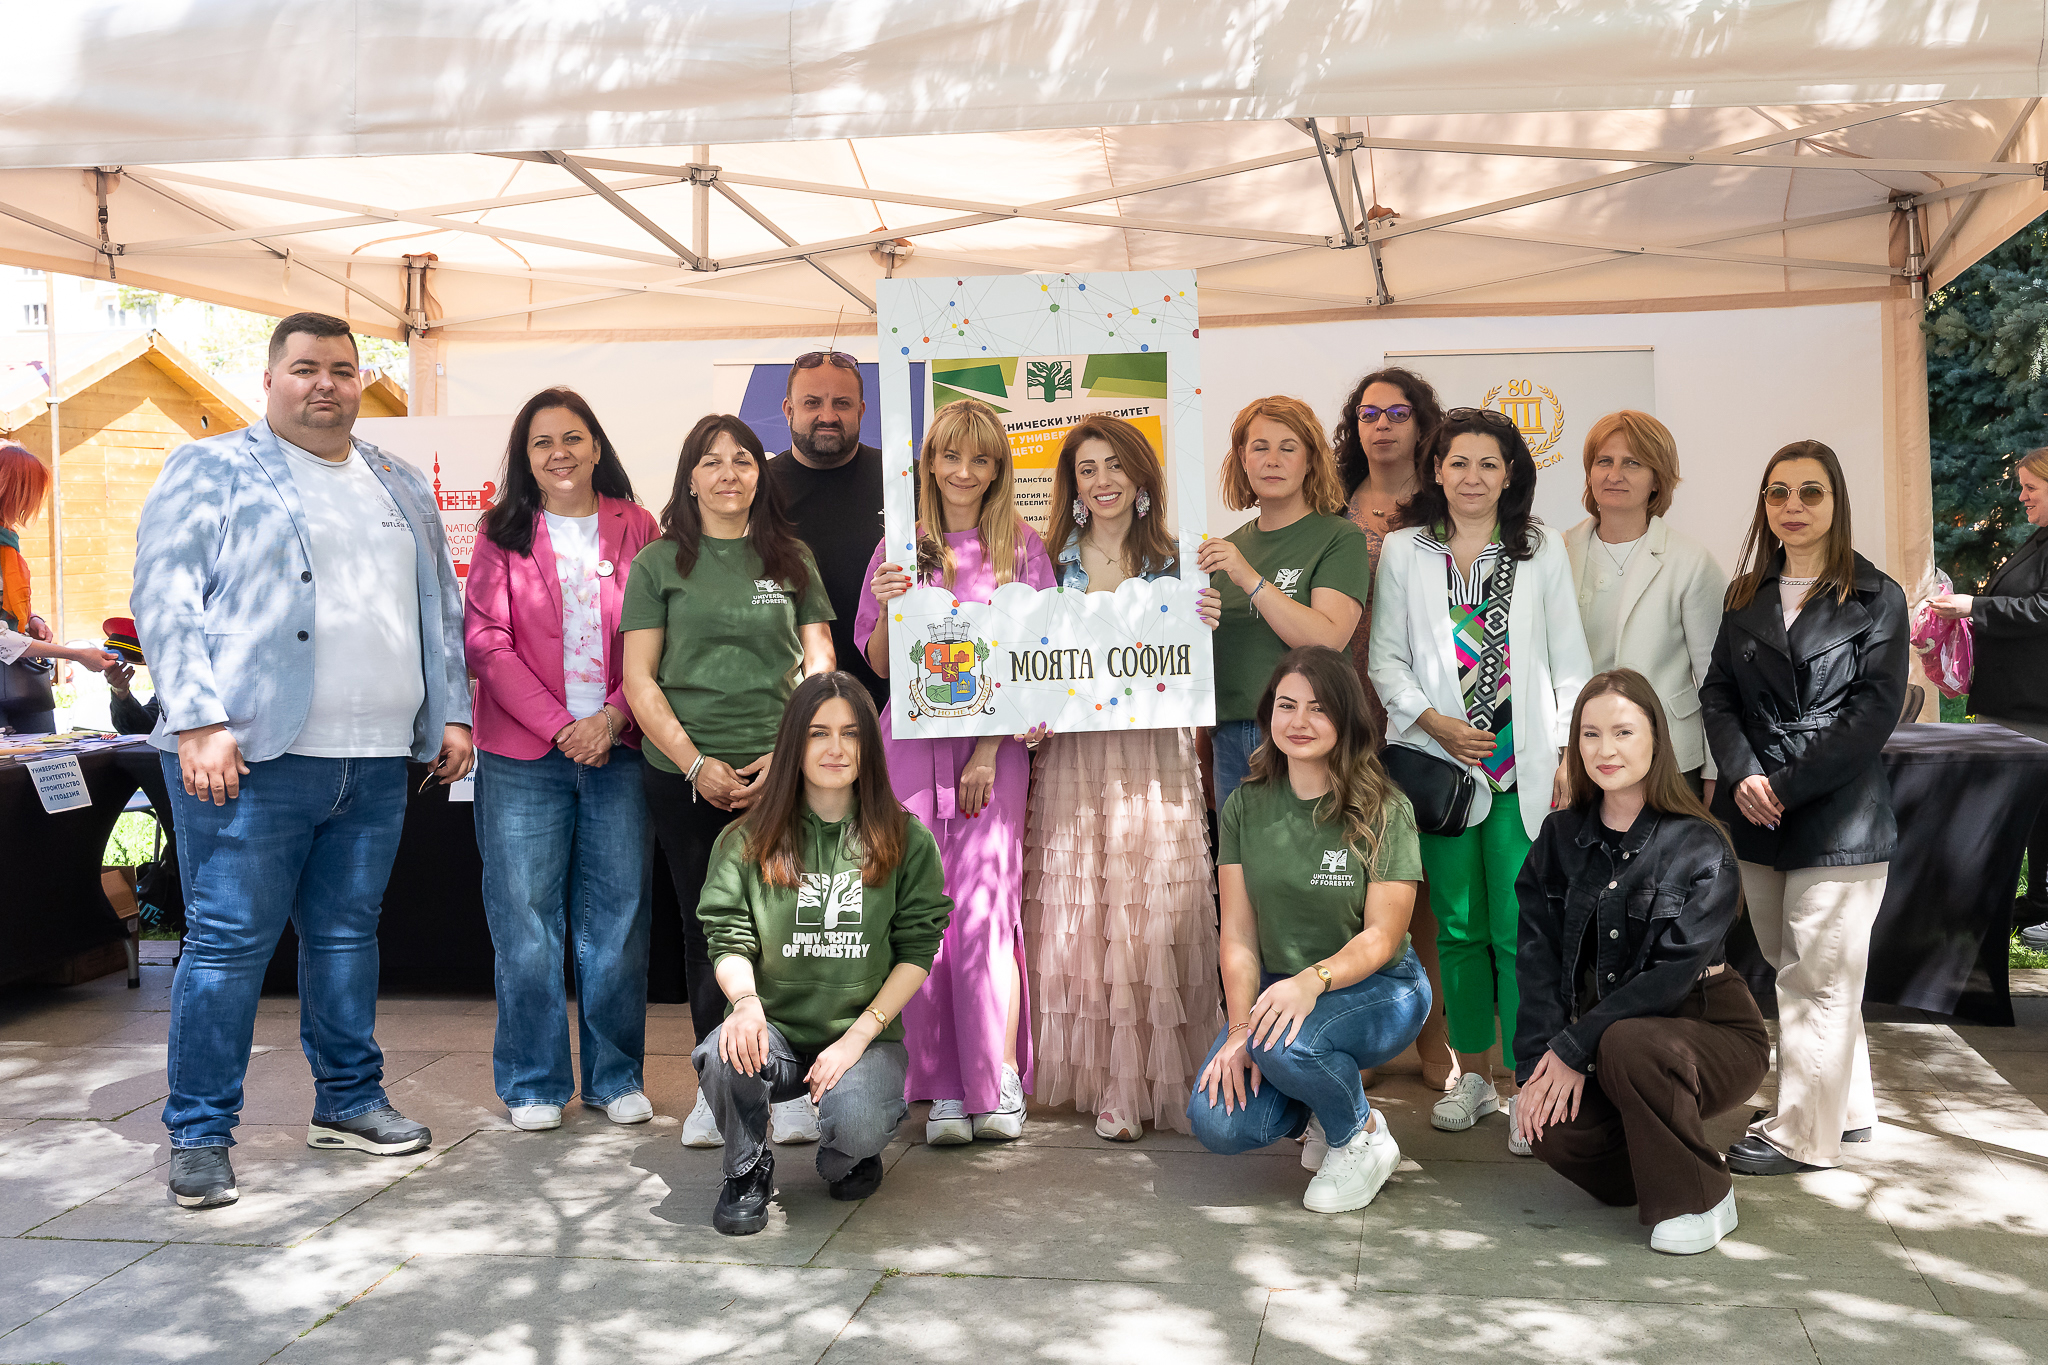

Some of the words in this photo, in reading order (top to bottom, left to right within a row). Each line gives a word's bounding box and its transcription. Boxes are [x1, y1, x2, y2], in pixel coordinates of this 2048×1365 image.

[1507, 379, 1533, 397] 80
[1003, 417, 1063, 432] НИЧЕСКИ
[1018, 430, 1069, 445] УНИВЕР
[1011, 444, 1044, 457] ЩЕТО
[1534, 451, 1564, 471] ВСКИ
[445, 523, 476, 533] NATIO
[447, 535, 477, 544] ACAD
[451, 546, 474, 556] OFIA
[1009, 648, 1095, 682] МОЯТА
[1107, 644, 1192, 678] СОФИЯ
[31, 762, 68, 774] УНИВЕРСИТЕТ
[40, 780, 81, 793] СТРОИТЕЛСТВО
[54, 790, 81, 801] ГЕОДЕЗИЯ
[1313, 873, 1353, 881] UNIVERSITY
[782, 943, 801, 958] OF
[803, 943, 871, 959] FORESTRY
